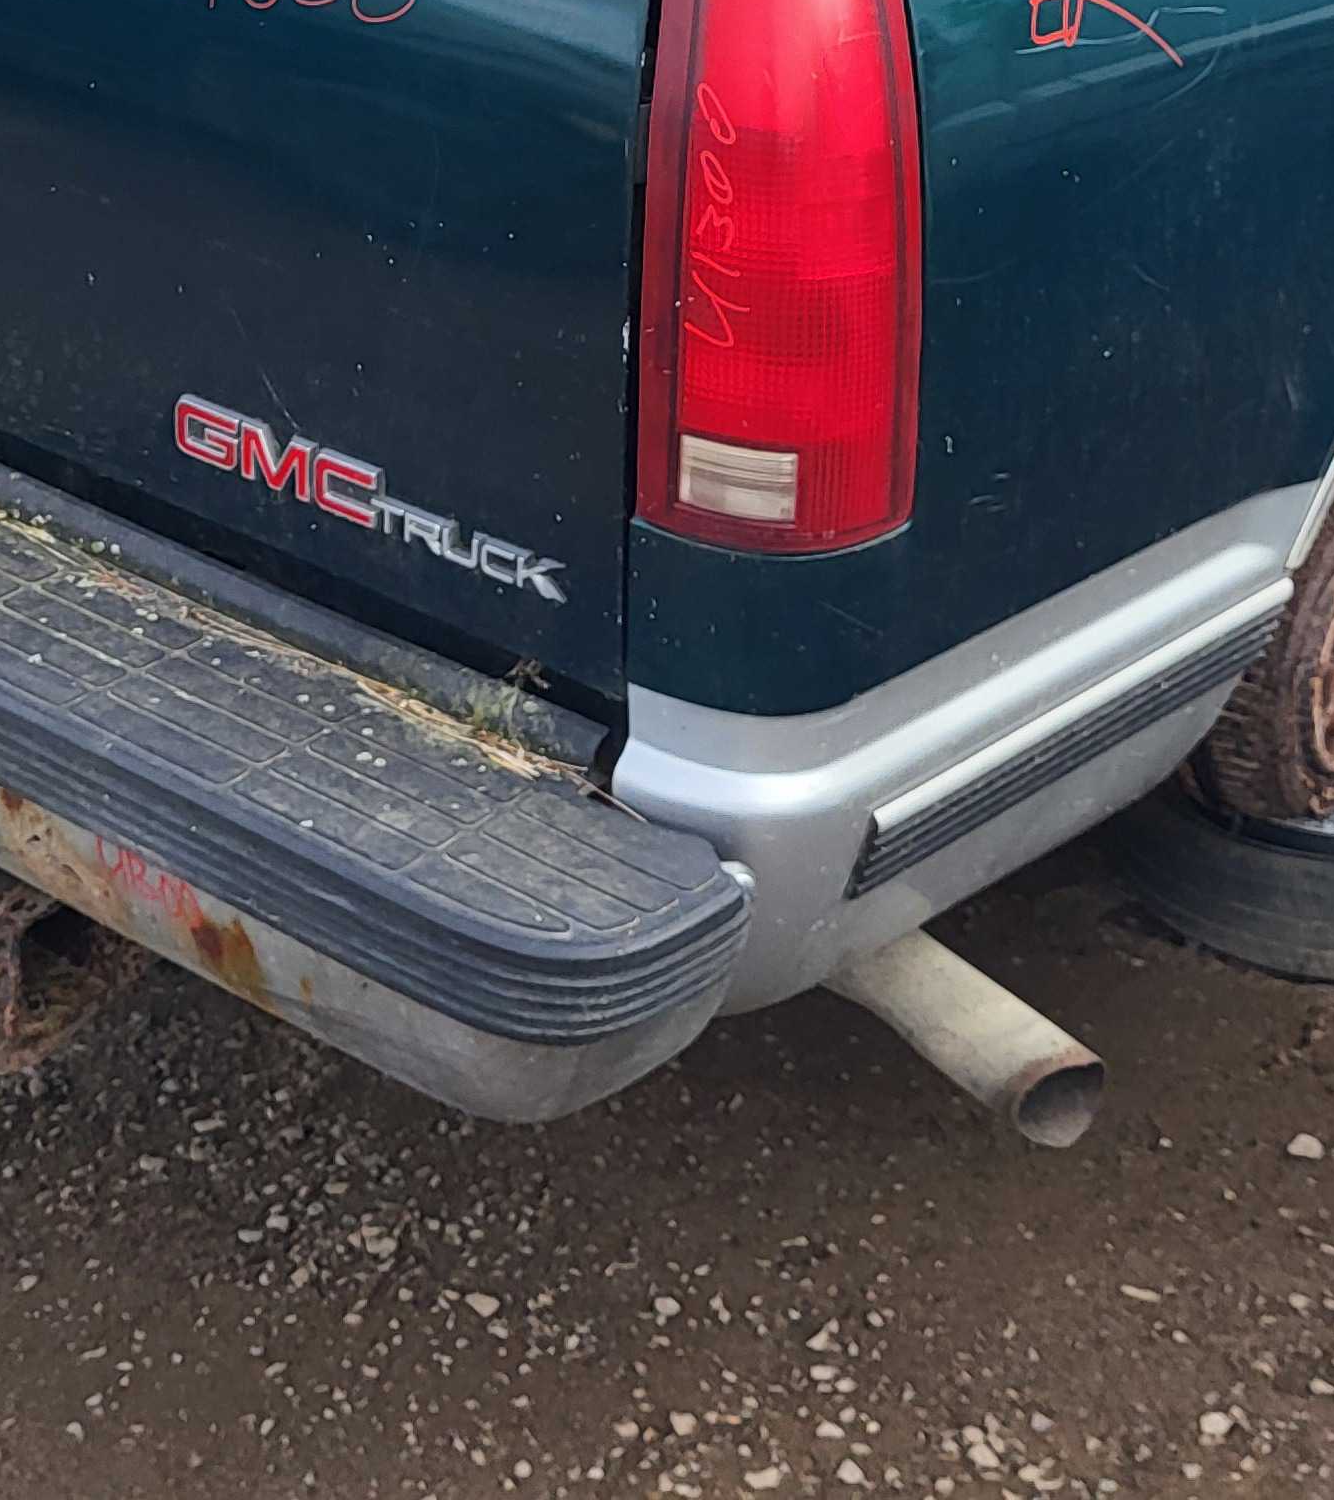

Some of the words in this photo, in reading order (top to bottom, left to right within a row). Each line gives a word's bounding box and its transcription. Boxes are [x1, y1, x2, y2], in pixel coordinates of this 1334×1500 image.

[684, 82, 750, 348] 41300
[174, 393, 386, 529] GMC
[370, 494, 568, 604] TRUCK
